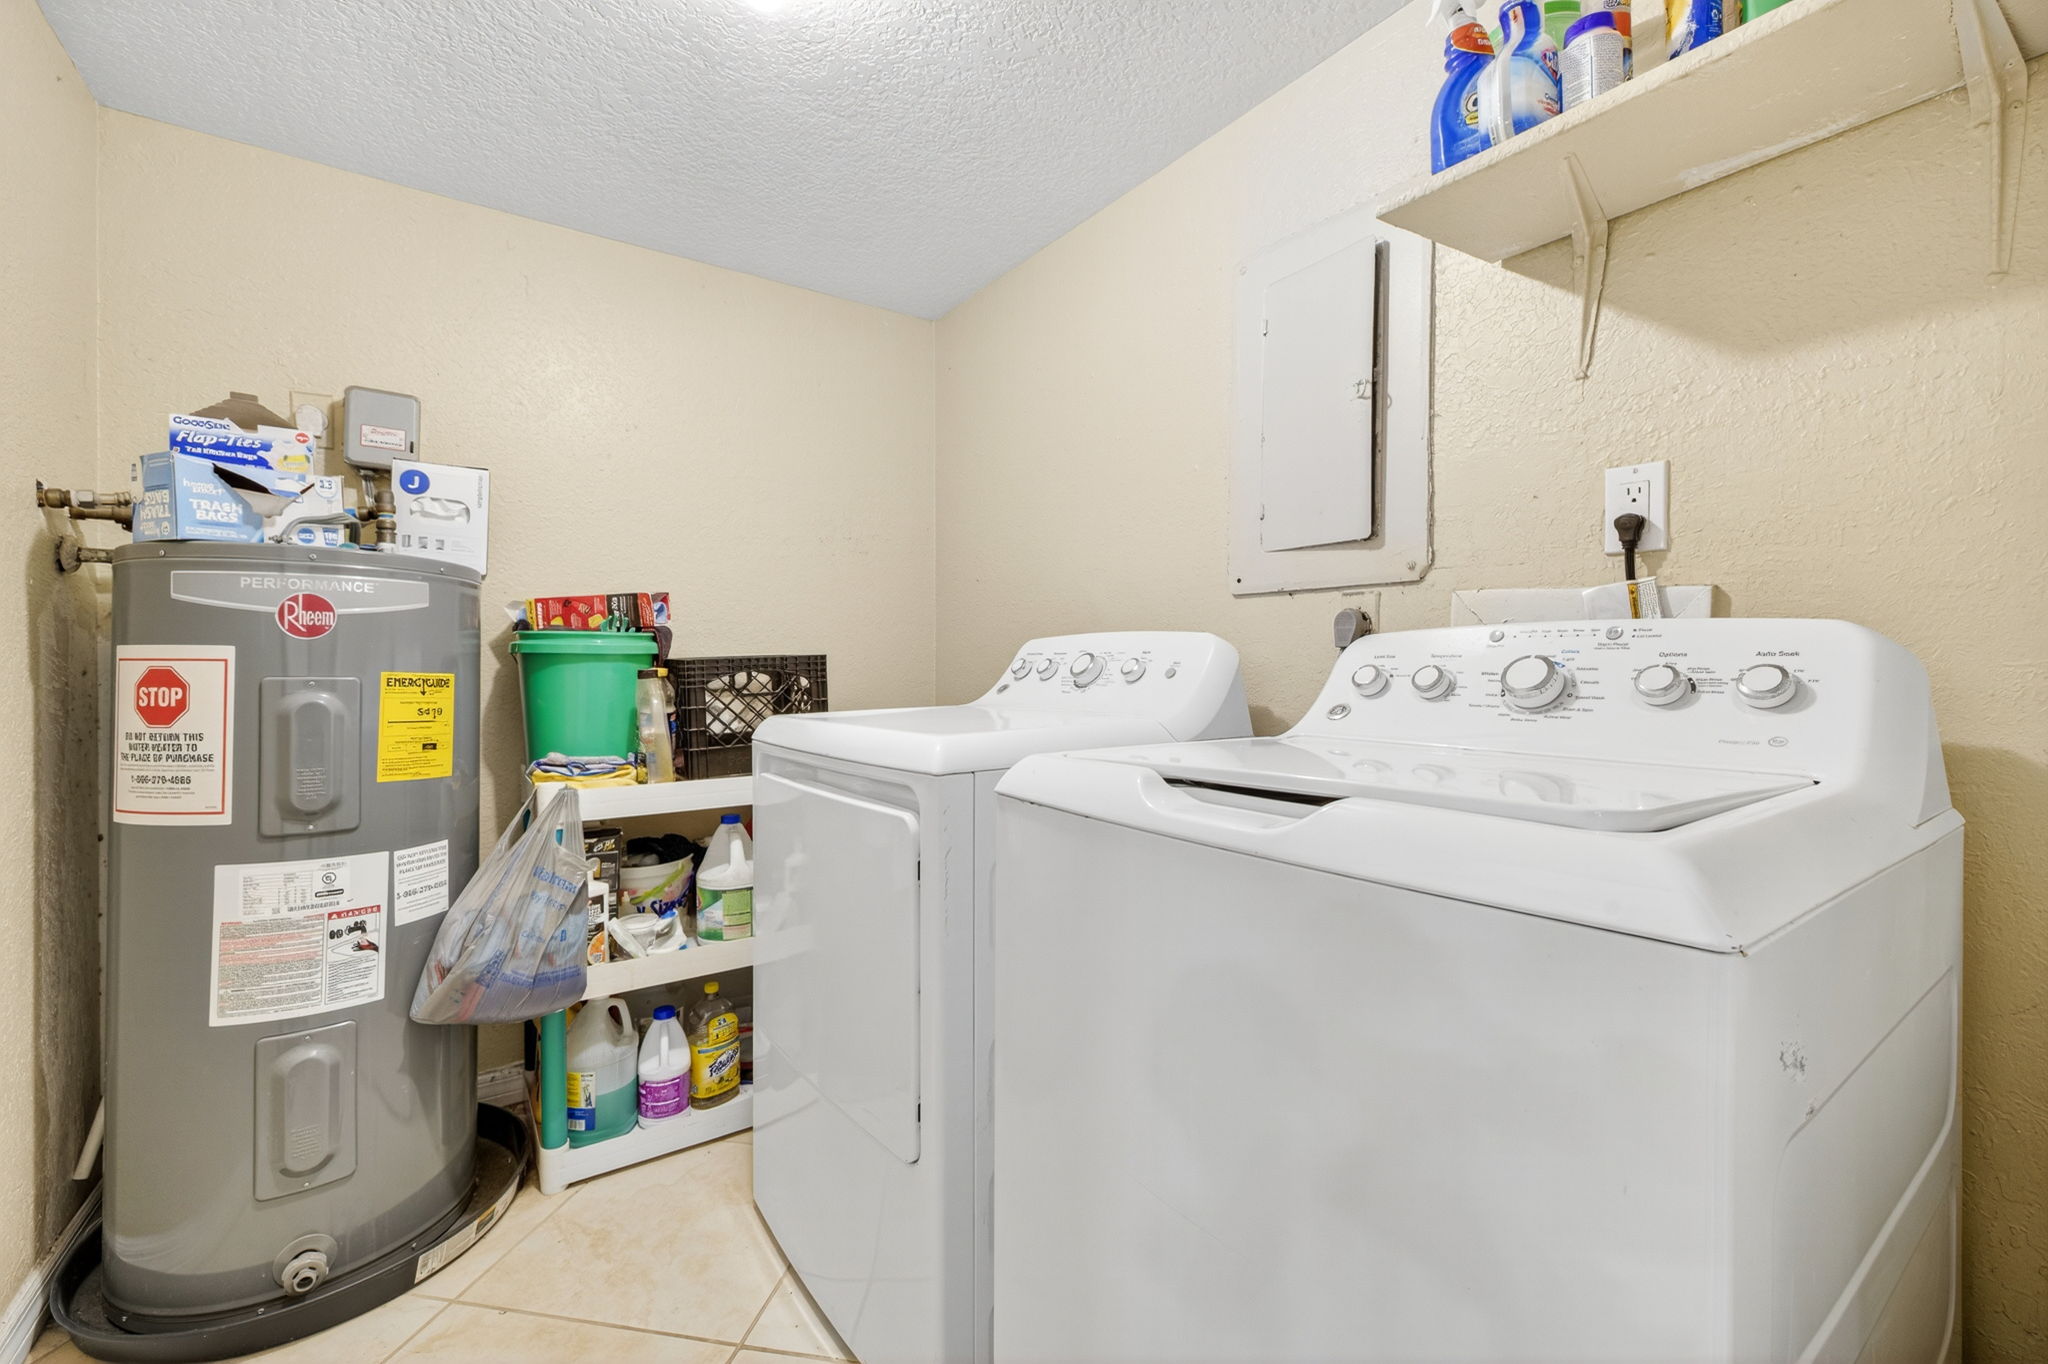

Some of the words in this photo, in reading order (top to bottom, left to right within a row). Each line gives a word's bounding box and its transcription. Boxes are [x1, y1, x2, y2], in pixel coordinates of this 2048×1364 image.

[176, 430, 261, 448] Flap-Ties
[408, 475, 419, 489] J
[189, 498, 243, 514] TRASH
[196, 509, 239, 523] BAGS
[284, 594, 334, 632] Rheem
[138, 686, 183, 707] STOP
[183, 732, 204, 742] THIS
[186, 743, 198, 752] TO
[165, 753, 214, 763] PURCHASE
